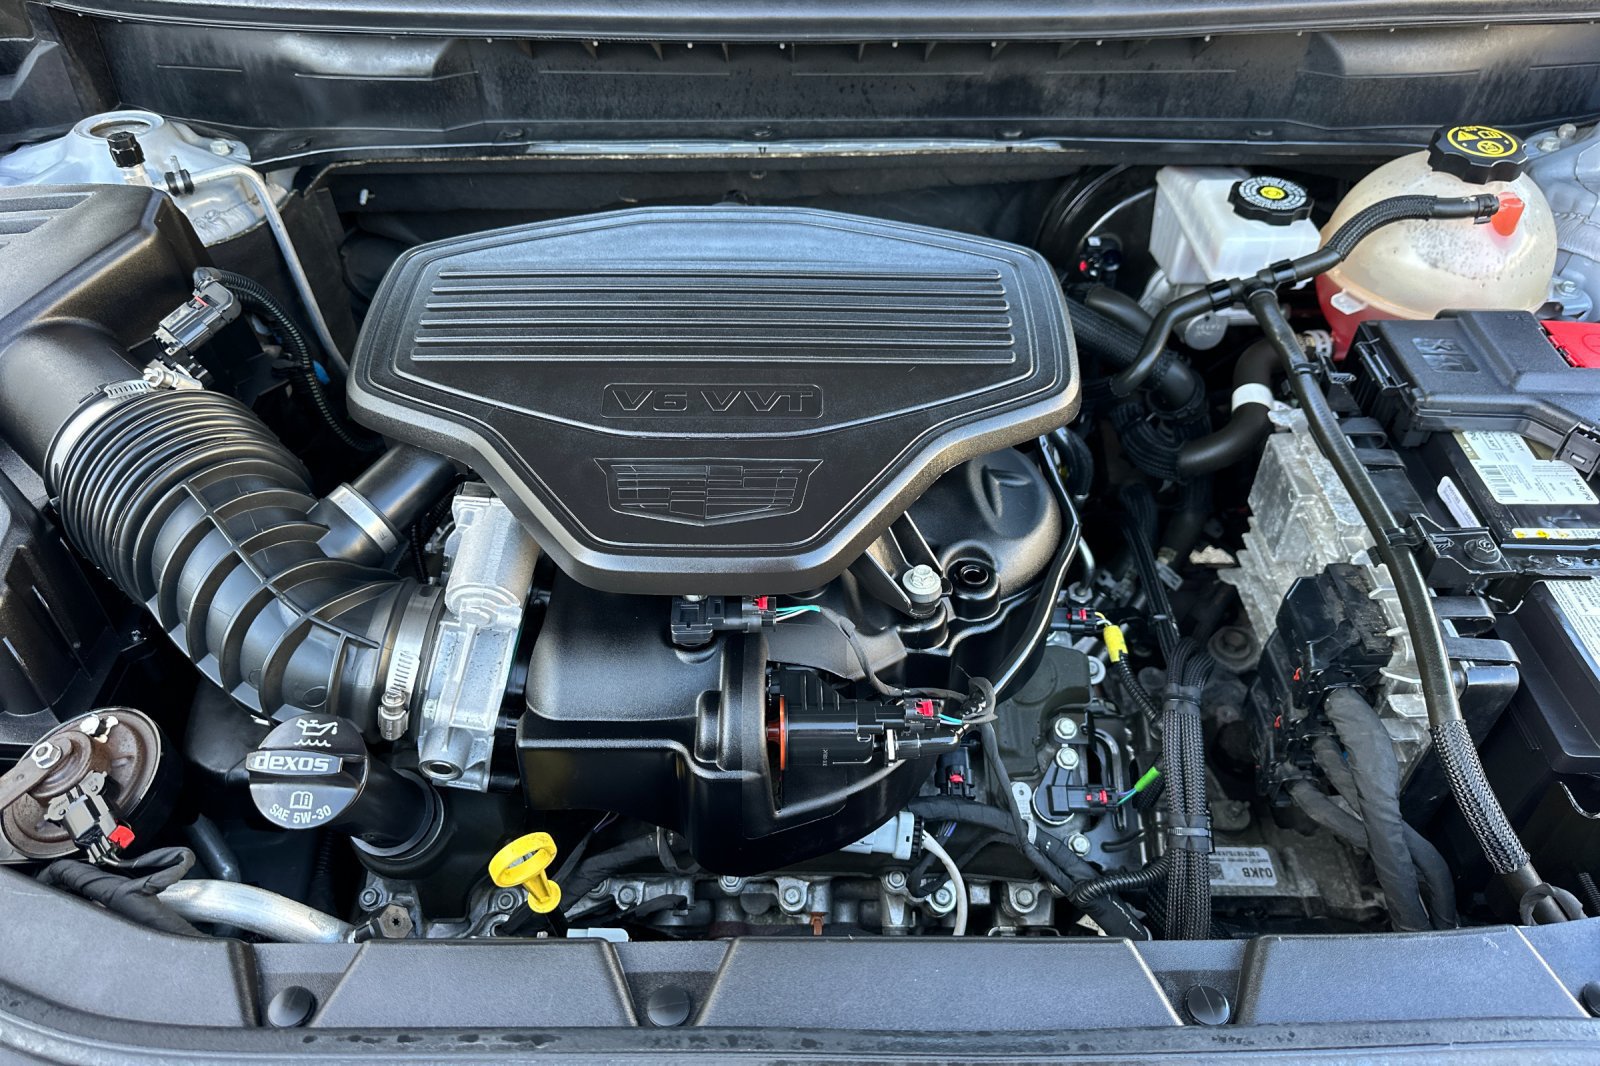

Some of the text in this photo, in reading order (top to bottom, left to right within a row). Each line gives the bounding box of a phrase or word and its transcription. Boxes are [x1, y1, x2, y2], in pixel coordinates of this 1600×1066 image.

[612, 390, 813, 412] V6 VVT
[253, 751, 331, 772] dexos
[269, 803, 332, 823] SAE 5W-30
